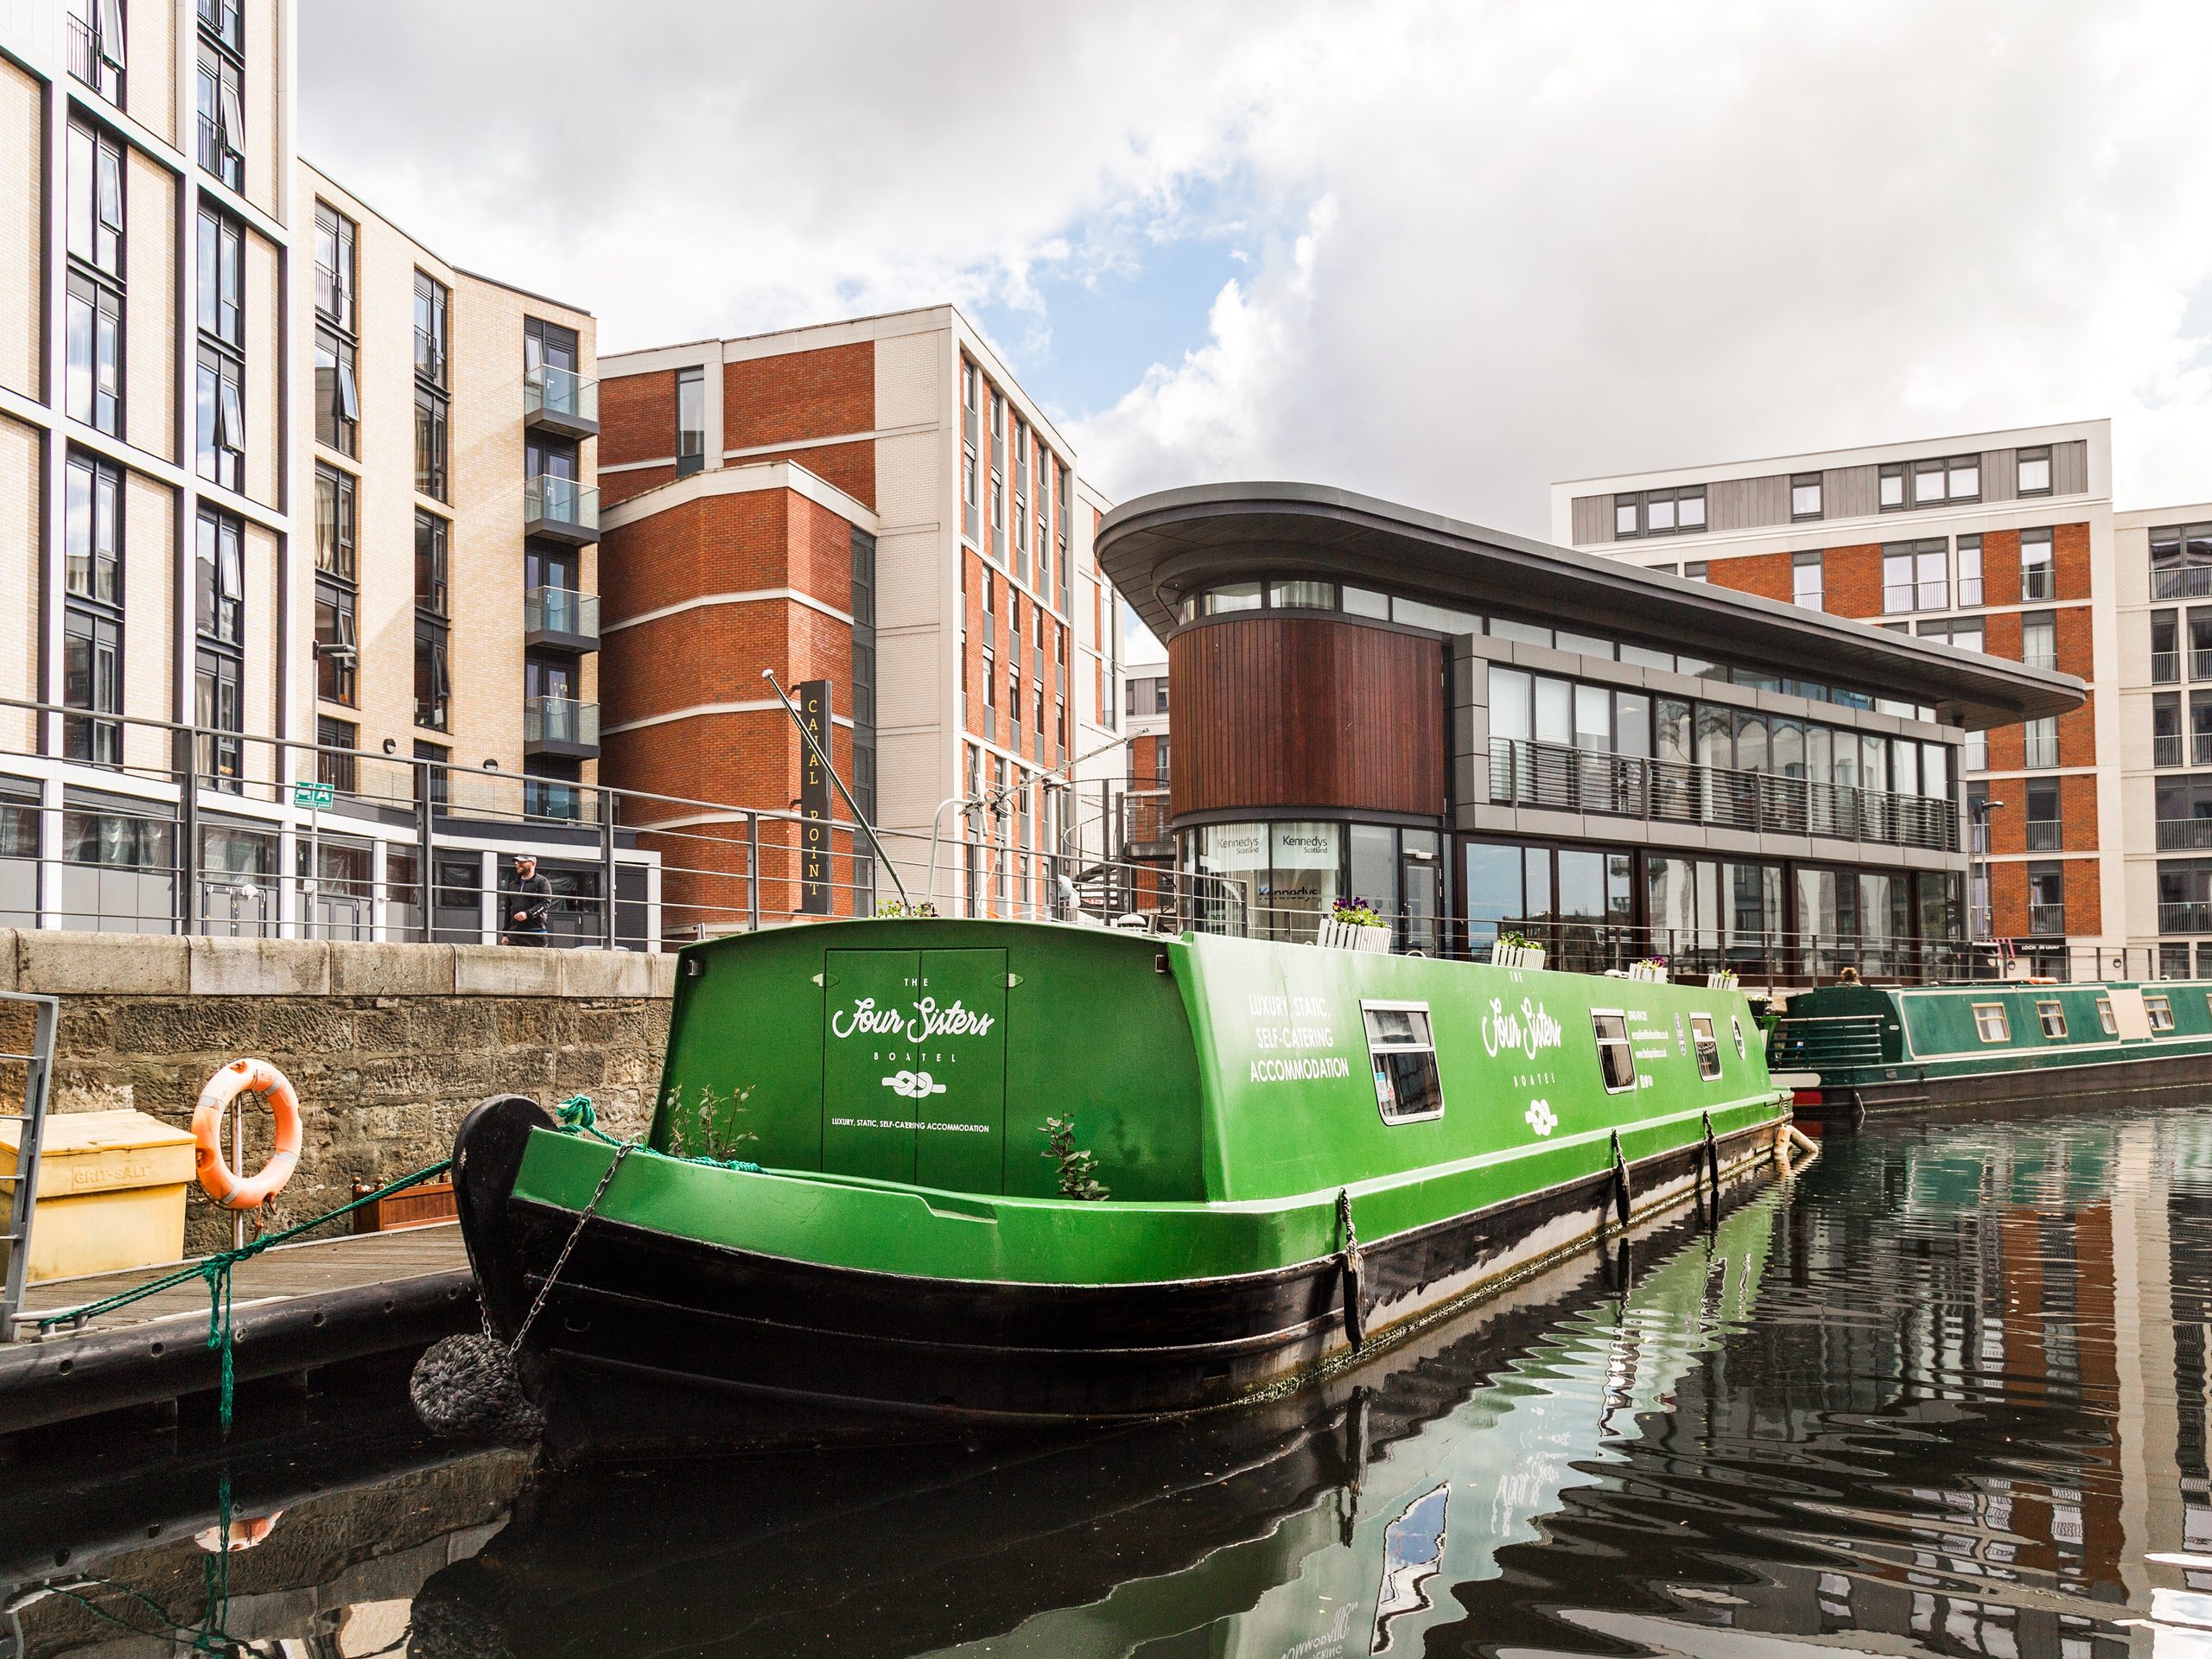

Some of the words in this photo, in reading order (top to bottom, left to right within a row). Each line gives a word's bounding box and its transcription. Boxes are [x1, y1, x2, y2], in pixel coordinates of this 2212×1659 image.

[1217, 836, 1259, 849] Kennedys
[1282, 835, 1328, 849] Kennedys
[809, 810, 820, 895] POINT
[904, 977, 929, 987] THE
[1509, 971, 1523, 983] THE
[1293, 996, 1331, 1020] STATIC,
[831, 997, 905, 1039] Four
[906, 996, 995, 1044] Sisters
[1481, 996, 1521, 1058] Four
[1521, 996, 1561, 1060] Sisters
[1255, 1027, 1334, 1049] SELF-CATERING
[874, 1052, 957, 1063] BOATEL
[1250, 1058, 1350, 1083] ACCOMMODATION
[1513, 1072, 1556, 1088] BOATEL
[831, 1117, 855, 1127] LUXURY,
[856, 1119, 879, 1128] STATIC,
[880, 1120, 926, 1130] SELF-CATERING
[926, 1122, 989, 1133] ACCOMMODATION
[74, 1166, 149, 1185] GRIT-SALT
